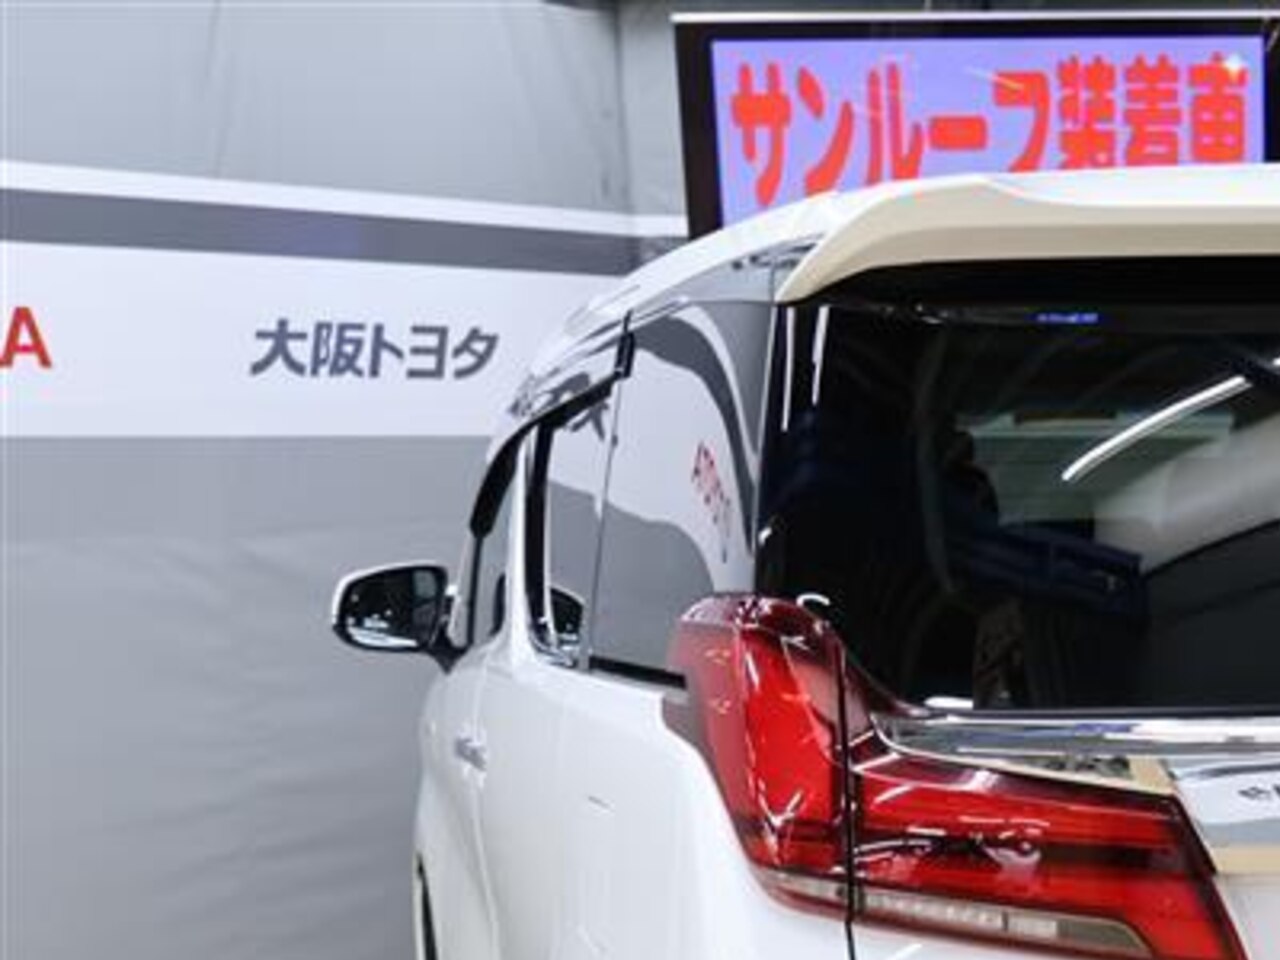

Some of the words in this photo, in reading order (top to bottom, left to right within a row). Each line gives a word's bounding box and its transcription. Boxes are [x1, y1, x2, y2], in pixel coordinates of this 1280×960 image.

[249, 318, 499, 380] 大阪トヨタ
